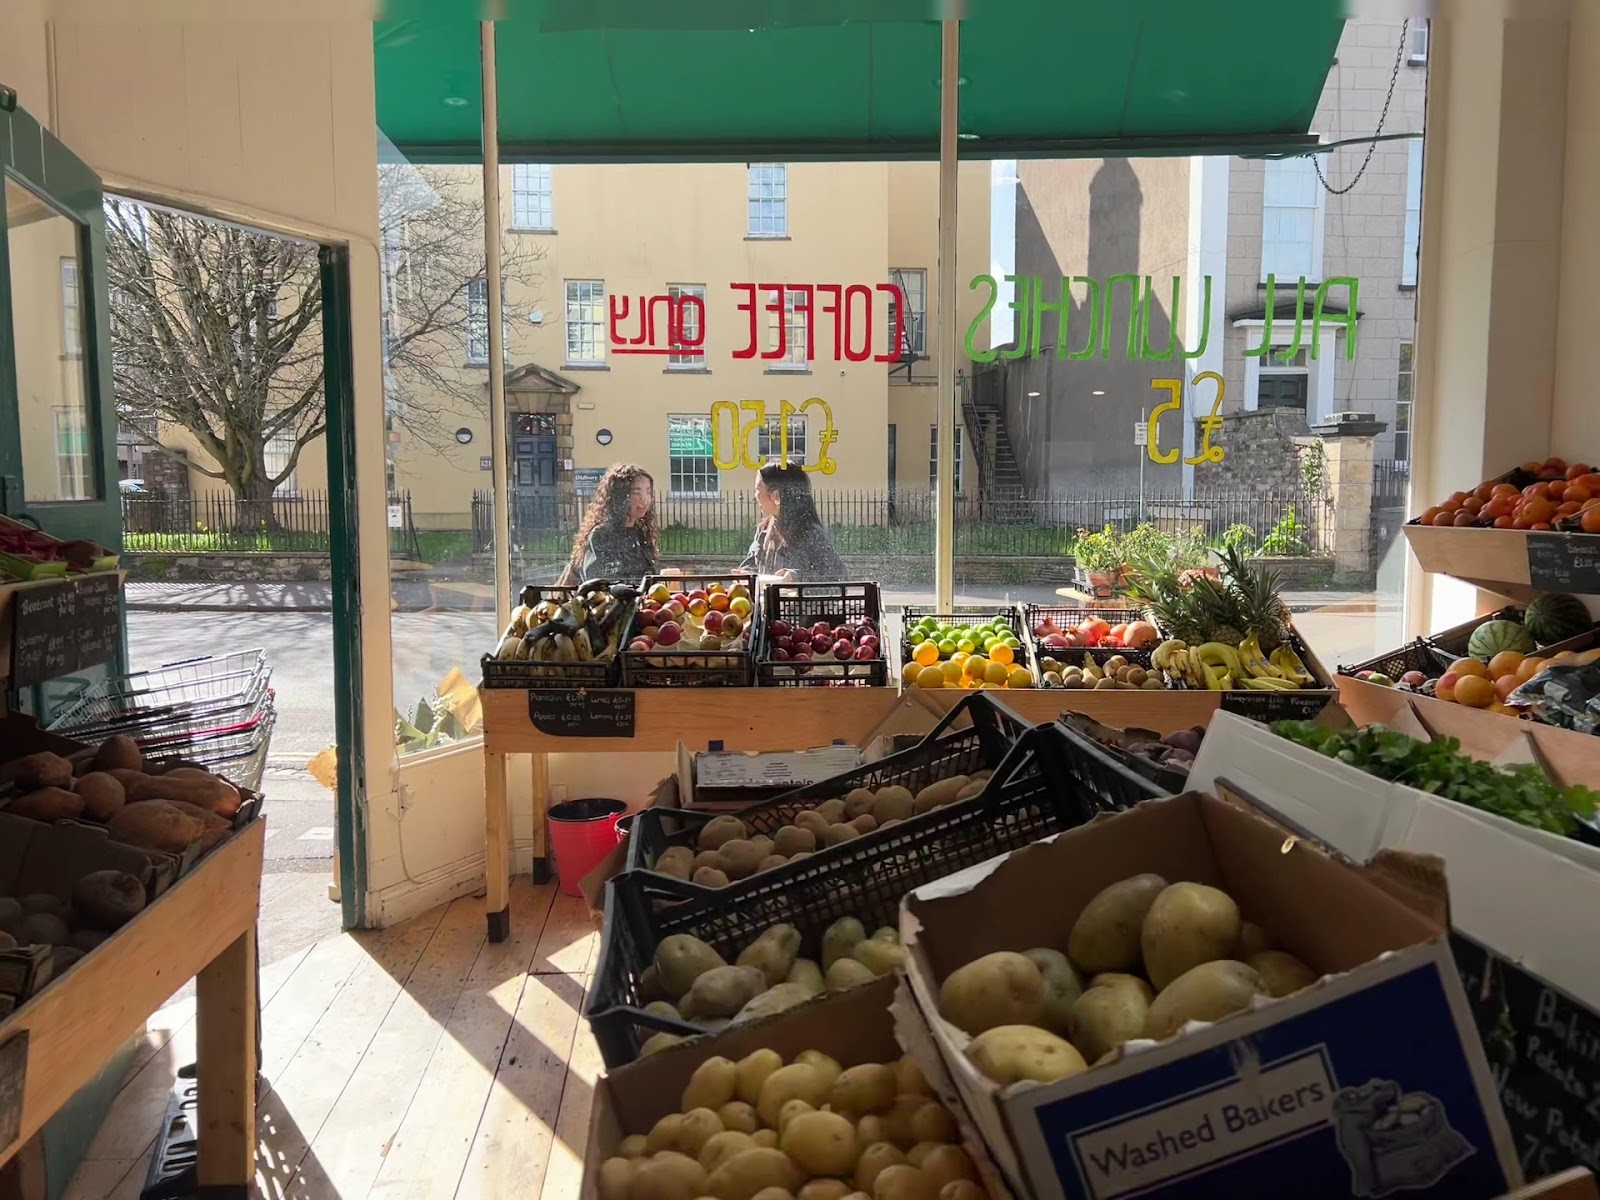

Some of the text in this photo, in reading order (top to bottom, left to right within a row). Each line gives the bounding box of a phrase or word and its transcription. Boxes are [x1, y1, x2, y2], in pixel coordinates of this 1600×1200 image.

[481, 459, 492, 467] 121
[530, 692, 563, 702] Plantain
[1090, 1081, 1326, 1177] Washed Bakers
